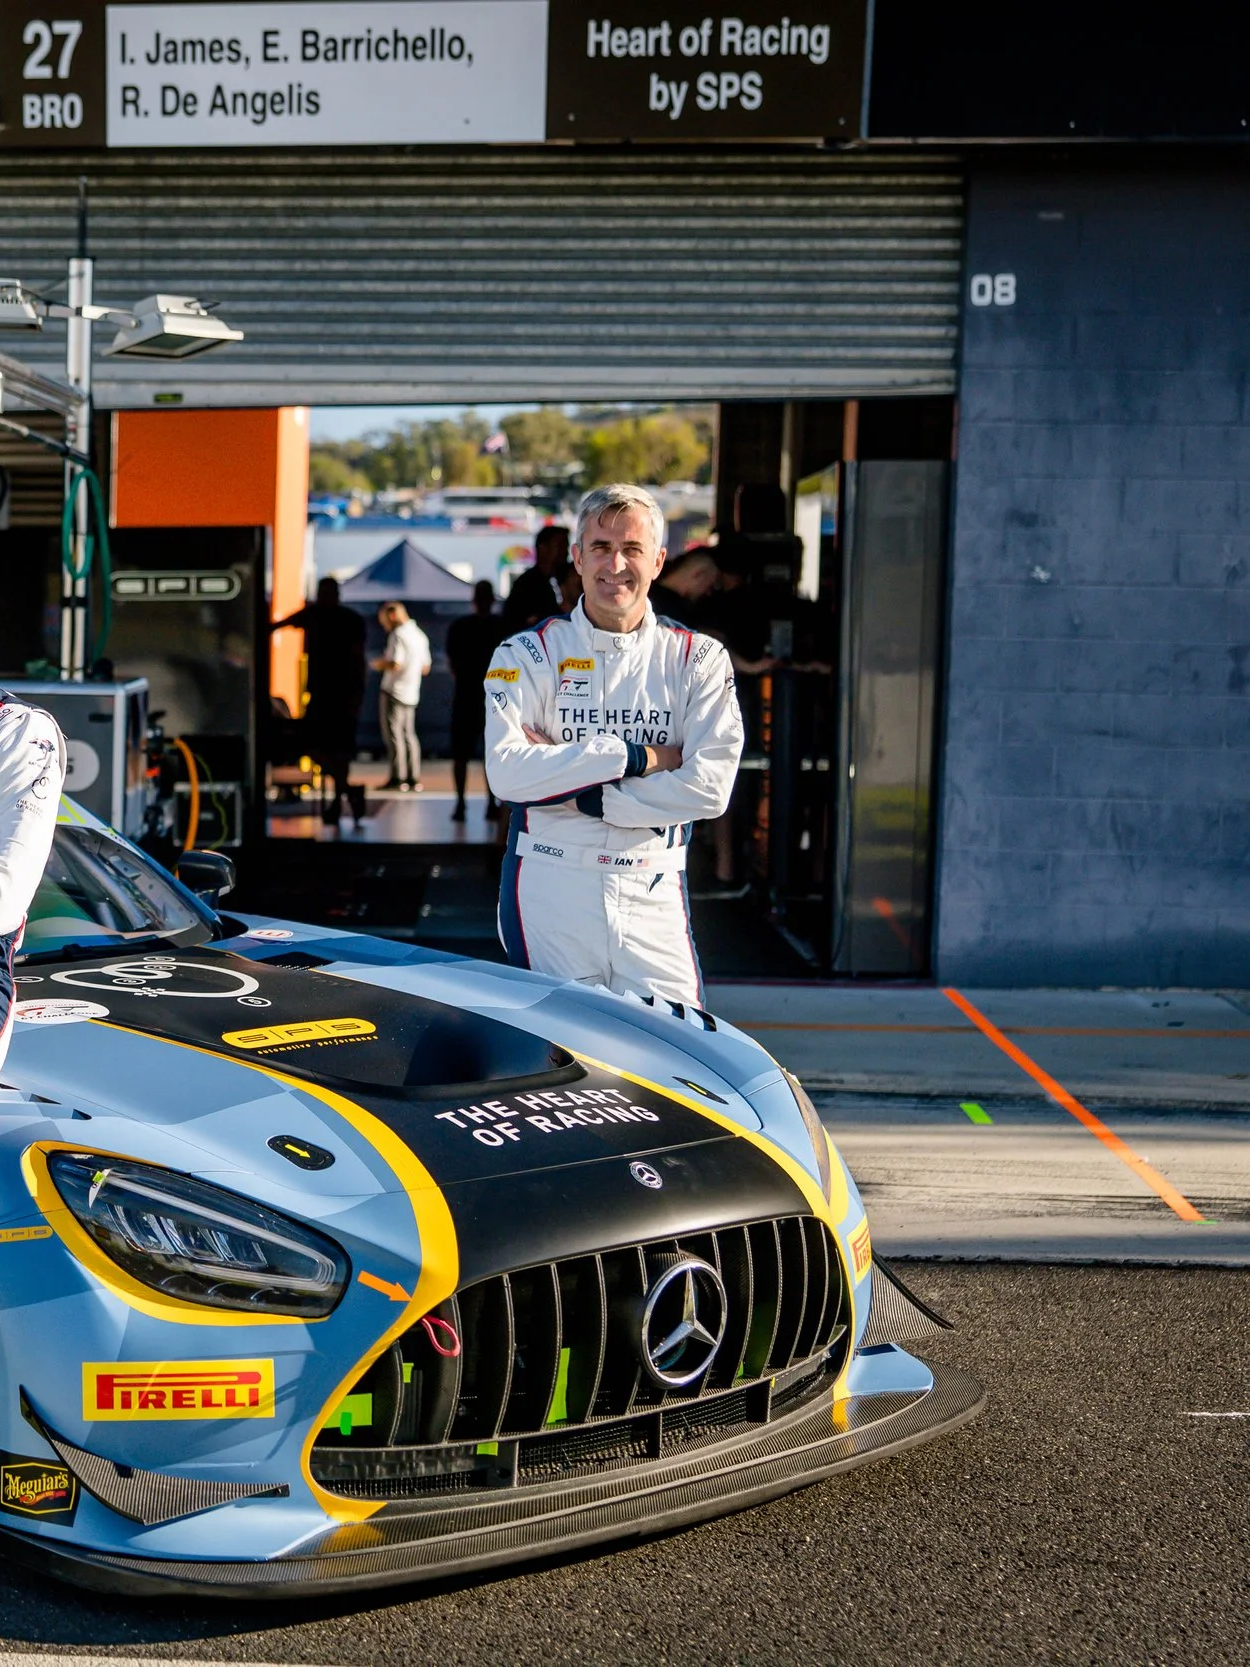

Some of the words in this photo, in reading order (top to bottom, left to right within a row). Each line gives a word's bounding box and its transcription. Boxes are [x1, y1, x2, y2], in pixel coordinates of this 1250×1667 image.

[22, 19, 83, 79] 27
[120, 33, 135, 64] I.
[146, 31, 250, 71] James,
[262, 30, 289, 63] E.
[301, 28, 473, 68] Barrichello,
[587, 19, 671, 57] Heart
[679, 17, 713, 56] of
[720, 16, 830, 64] Racing
[22, 93, 83, 129] BRO
[122, 86, 149, 118] R.
[161, 85, 198, 117] De
[209, 83, 320, 125] Angelis
[649, 73, 689, 120] by
[696, 70, 763, 111] SPS
[970, 273, 1016, 307] 08
[517, 635, 543, 664] sparco
[559, 708, 599, 724] THE
[606, 709, 671, 726] HEART
[562, 728, 587, 743] OF
[532, 843, 564, 857] sparco
[614, 857, 633, 866] IAN
[257, 1042, 311, 1055] automotive
[317, 1034, 379, 1047] performance
[434, 1100, 520, 1129] THE
[514, 1088, 633, 1111] HEART
[472, 1122, 521, 1147] OF
[524, 1105, 660, 1133] RACING
[96, 1371, 261, 1410] PIRELLI
[4, 1471, 69, 1504] Meguiar's
